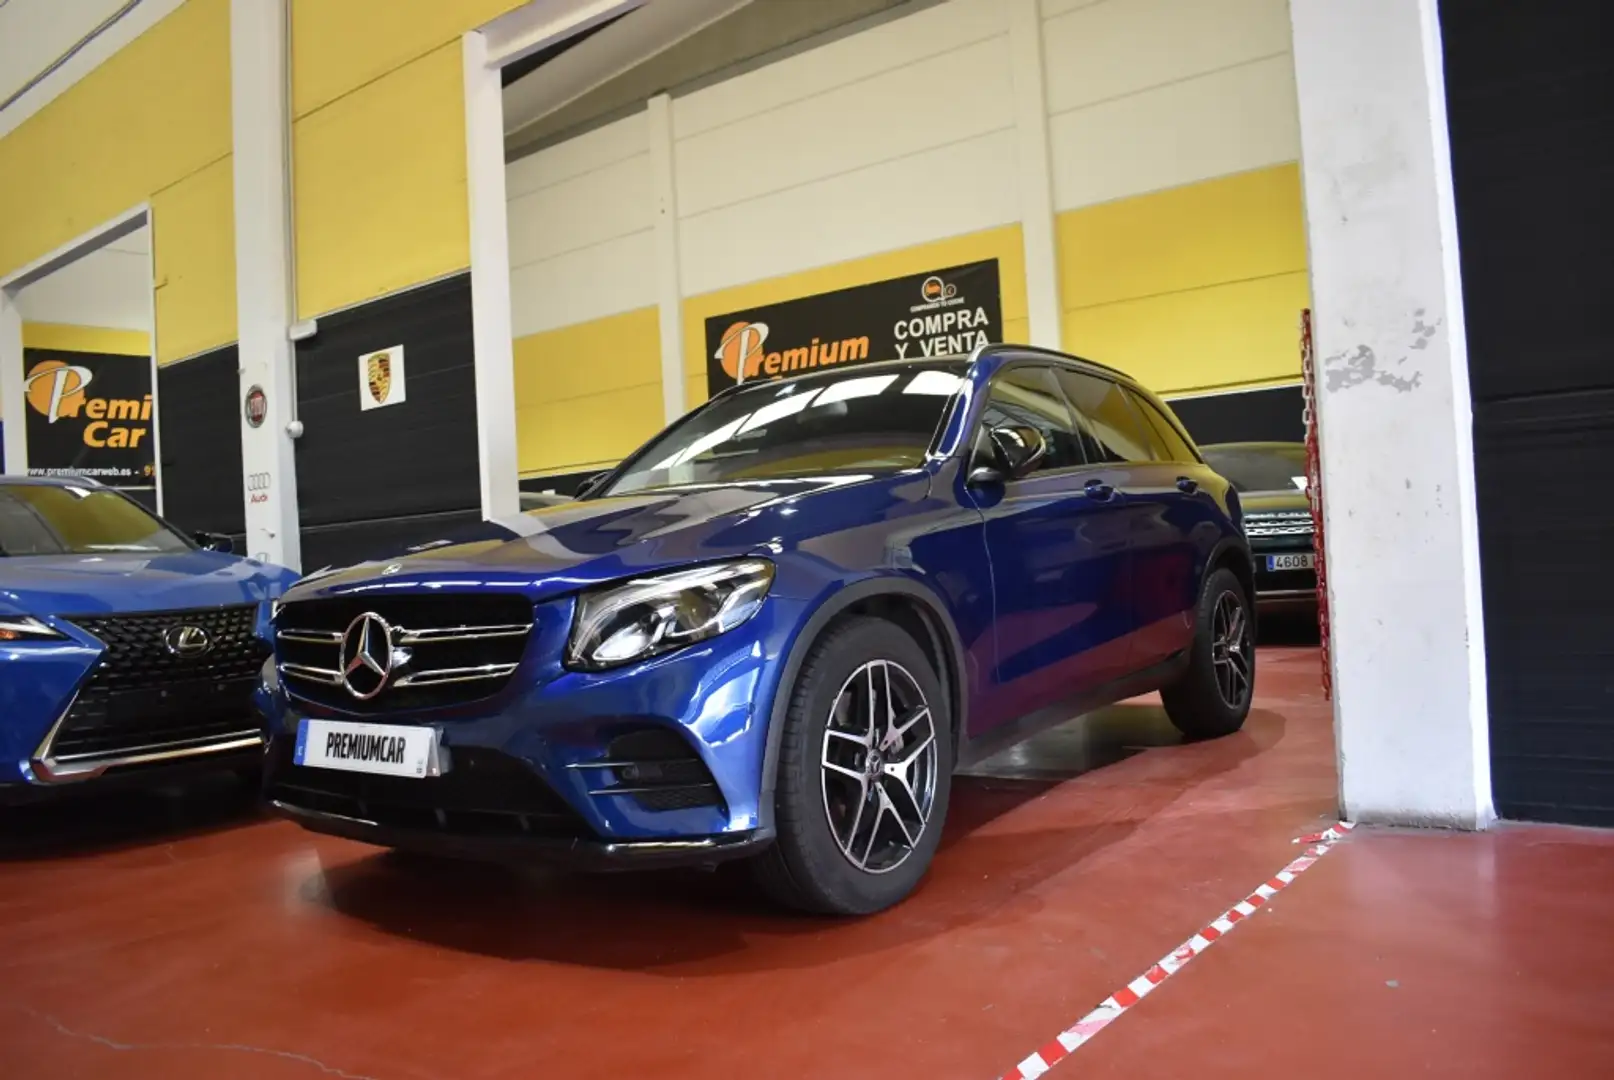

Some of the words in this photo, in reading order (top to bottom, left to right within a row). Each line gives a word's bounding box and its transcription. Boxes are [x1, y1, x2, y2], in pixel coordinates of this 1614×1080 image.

[893, 306, 989, 340] COMPRA
[714, 322, 870, 385] Premium
[894, 342, 909, 360] Y
[919, 330, 989, 357] VENTA
[83, 420, 147, 448] Car
[1275, 555, 1308, 568] 4608
[325, 731, 407, 764] PREMIUMCAR
